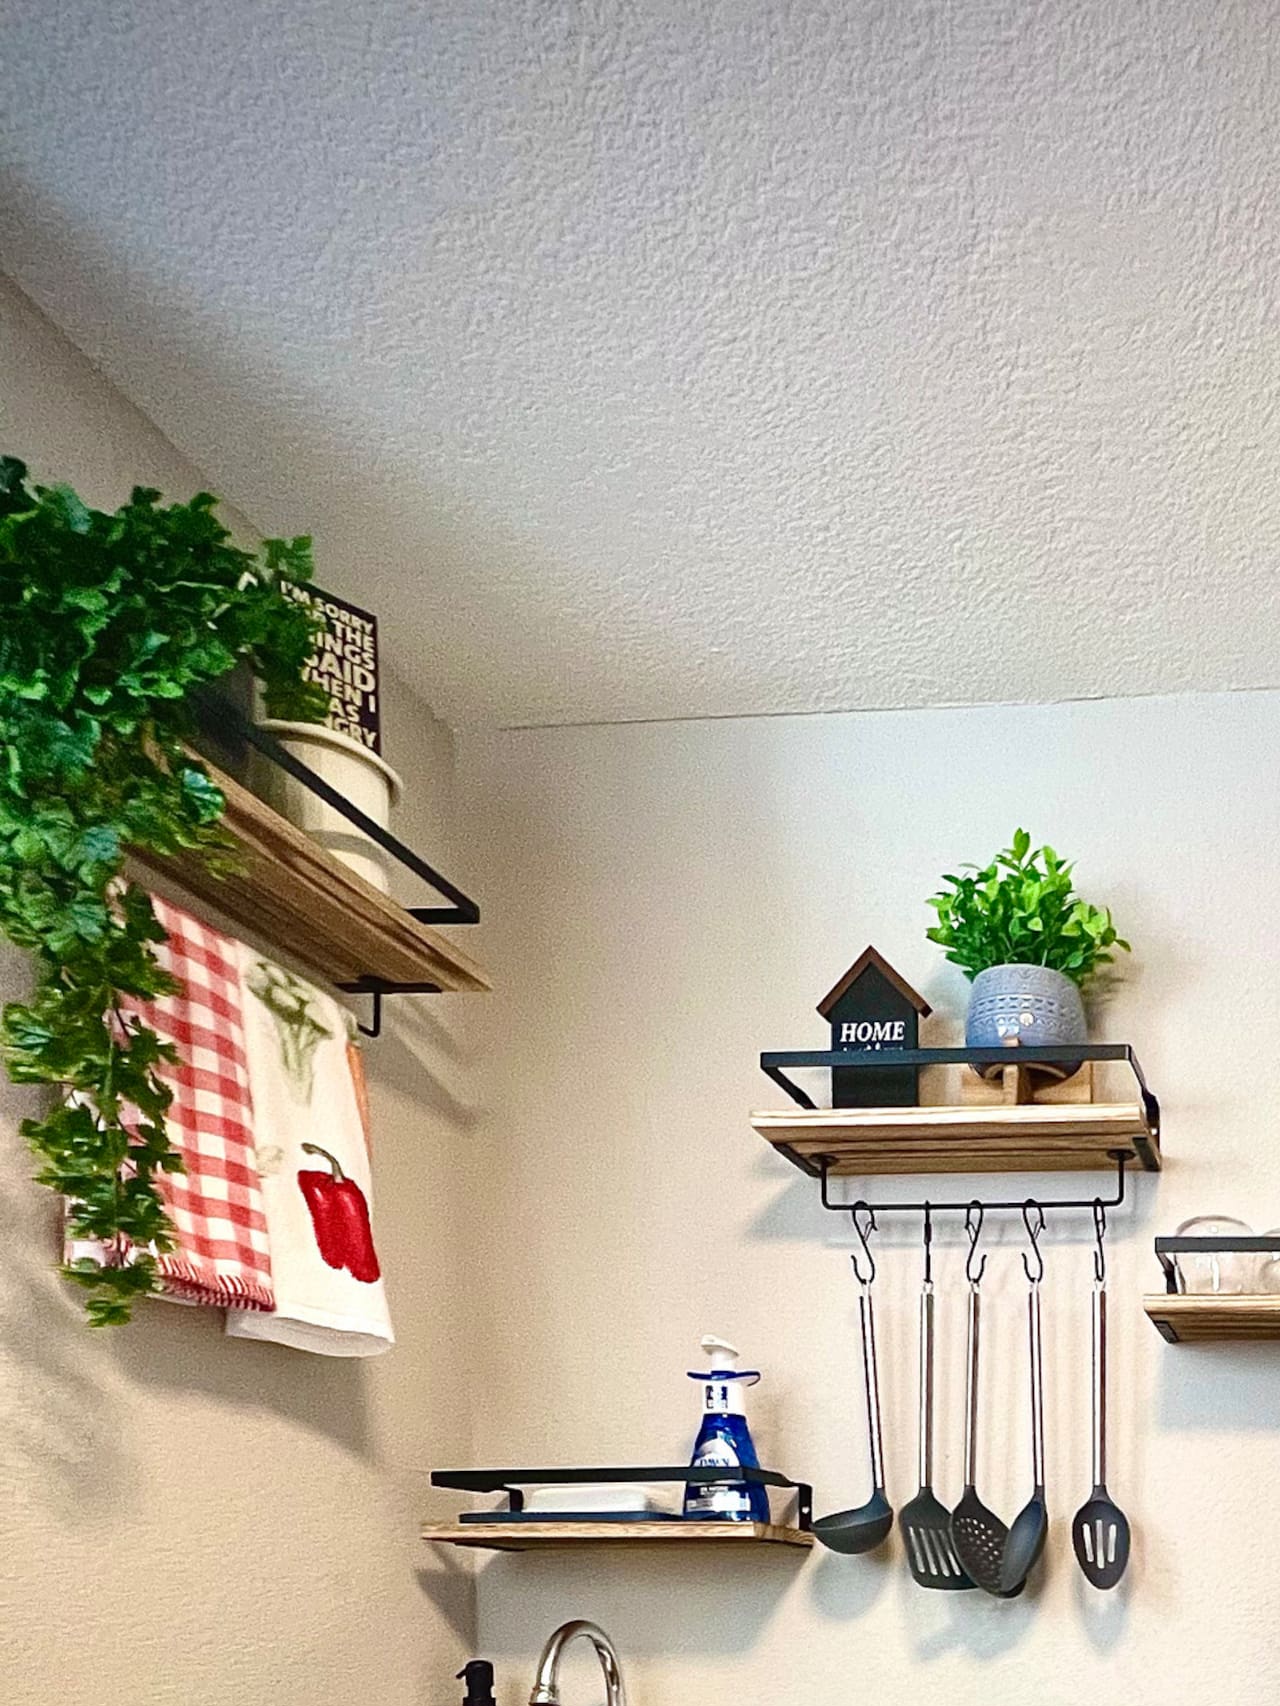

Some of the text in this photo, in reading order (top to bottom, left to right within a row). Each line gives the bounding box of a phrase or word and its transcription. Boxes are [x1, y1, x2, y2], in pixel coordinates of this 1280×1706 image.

[313, 597, 374, 635] SORRY
[308, 631, 375, 670] INGS
[330, 619, 375, 652] THE
[329, 697, 361, 723] AS
[840, 1021, 905, 1042] HOME
